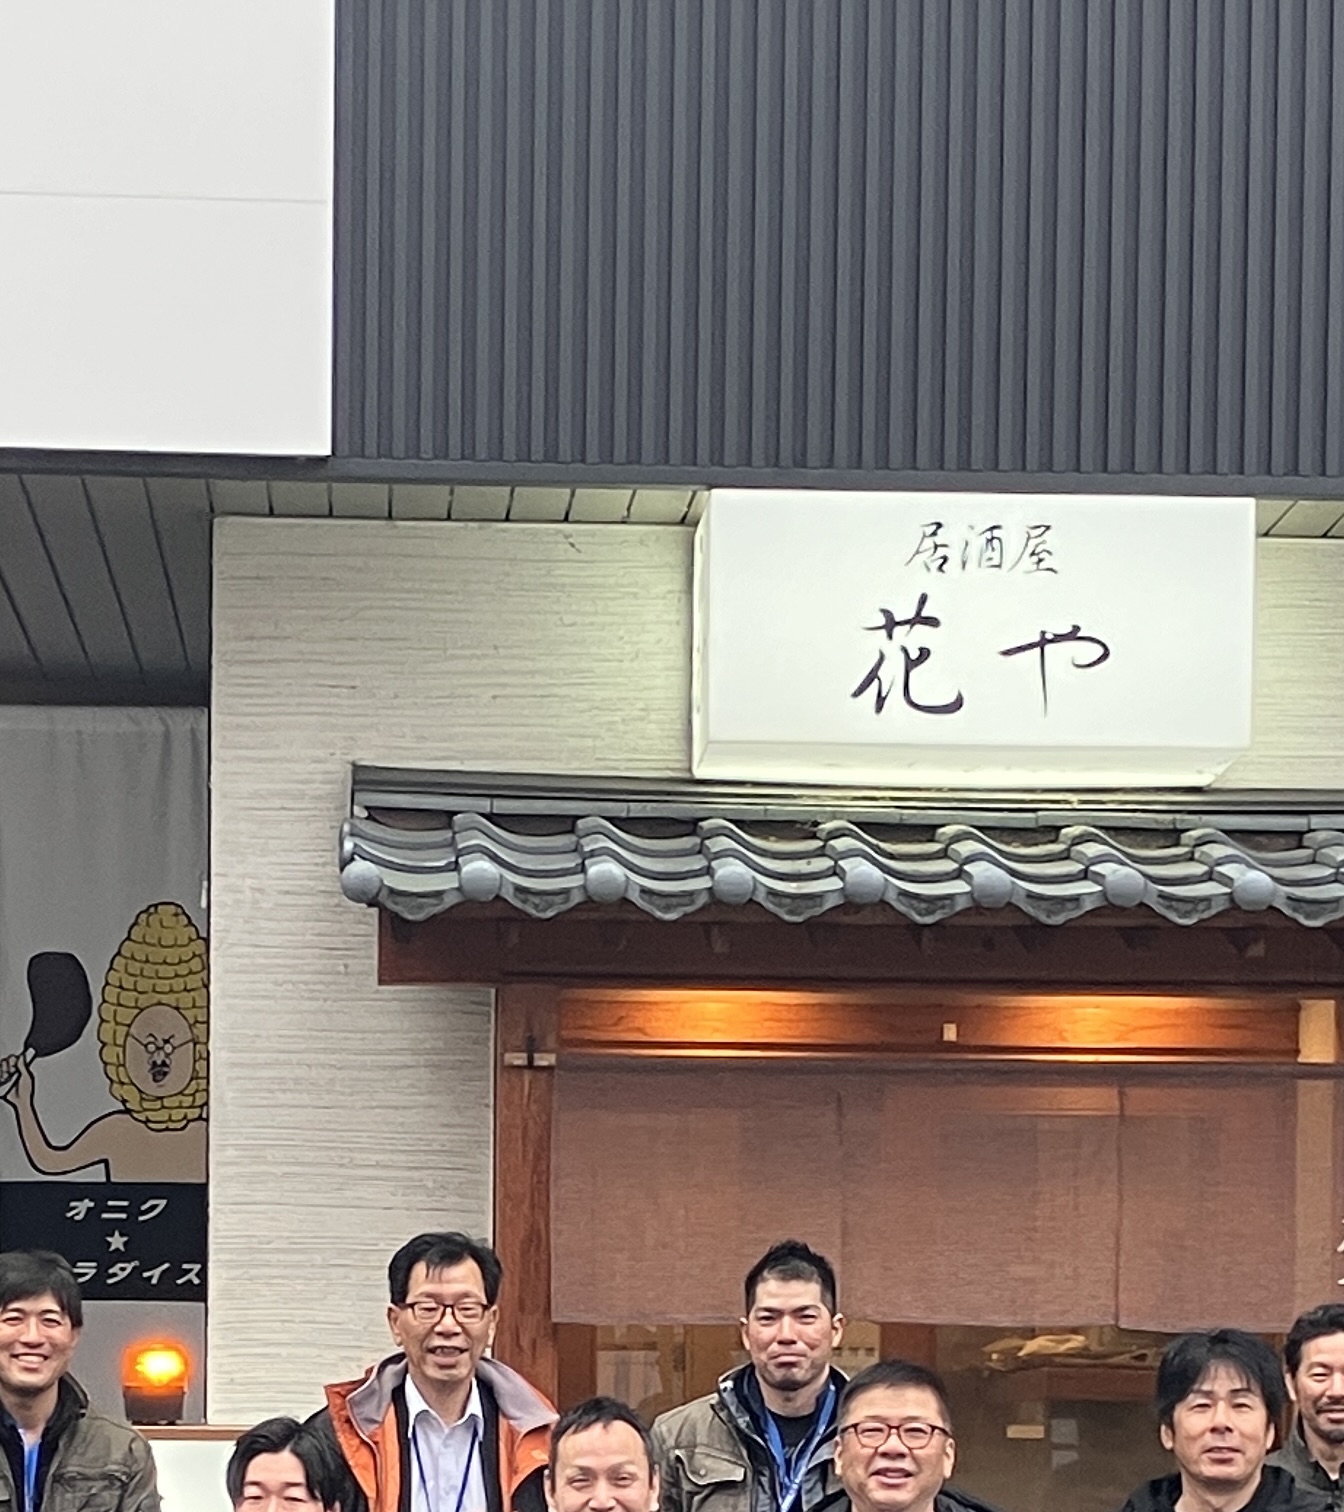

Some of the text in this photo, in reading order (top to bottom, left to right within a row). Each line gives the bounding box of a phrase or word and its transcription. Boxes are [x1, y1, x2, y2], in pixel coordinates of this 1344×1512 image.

[904, 521, 1059, 575] 居酒屋
[850, 592, 1111, 719] 花や
[64, 1197, 169, 1222] オニク
[70, 1259, 203, 1285] ラダイス
